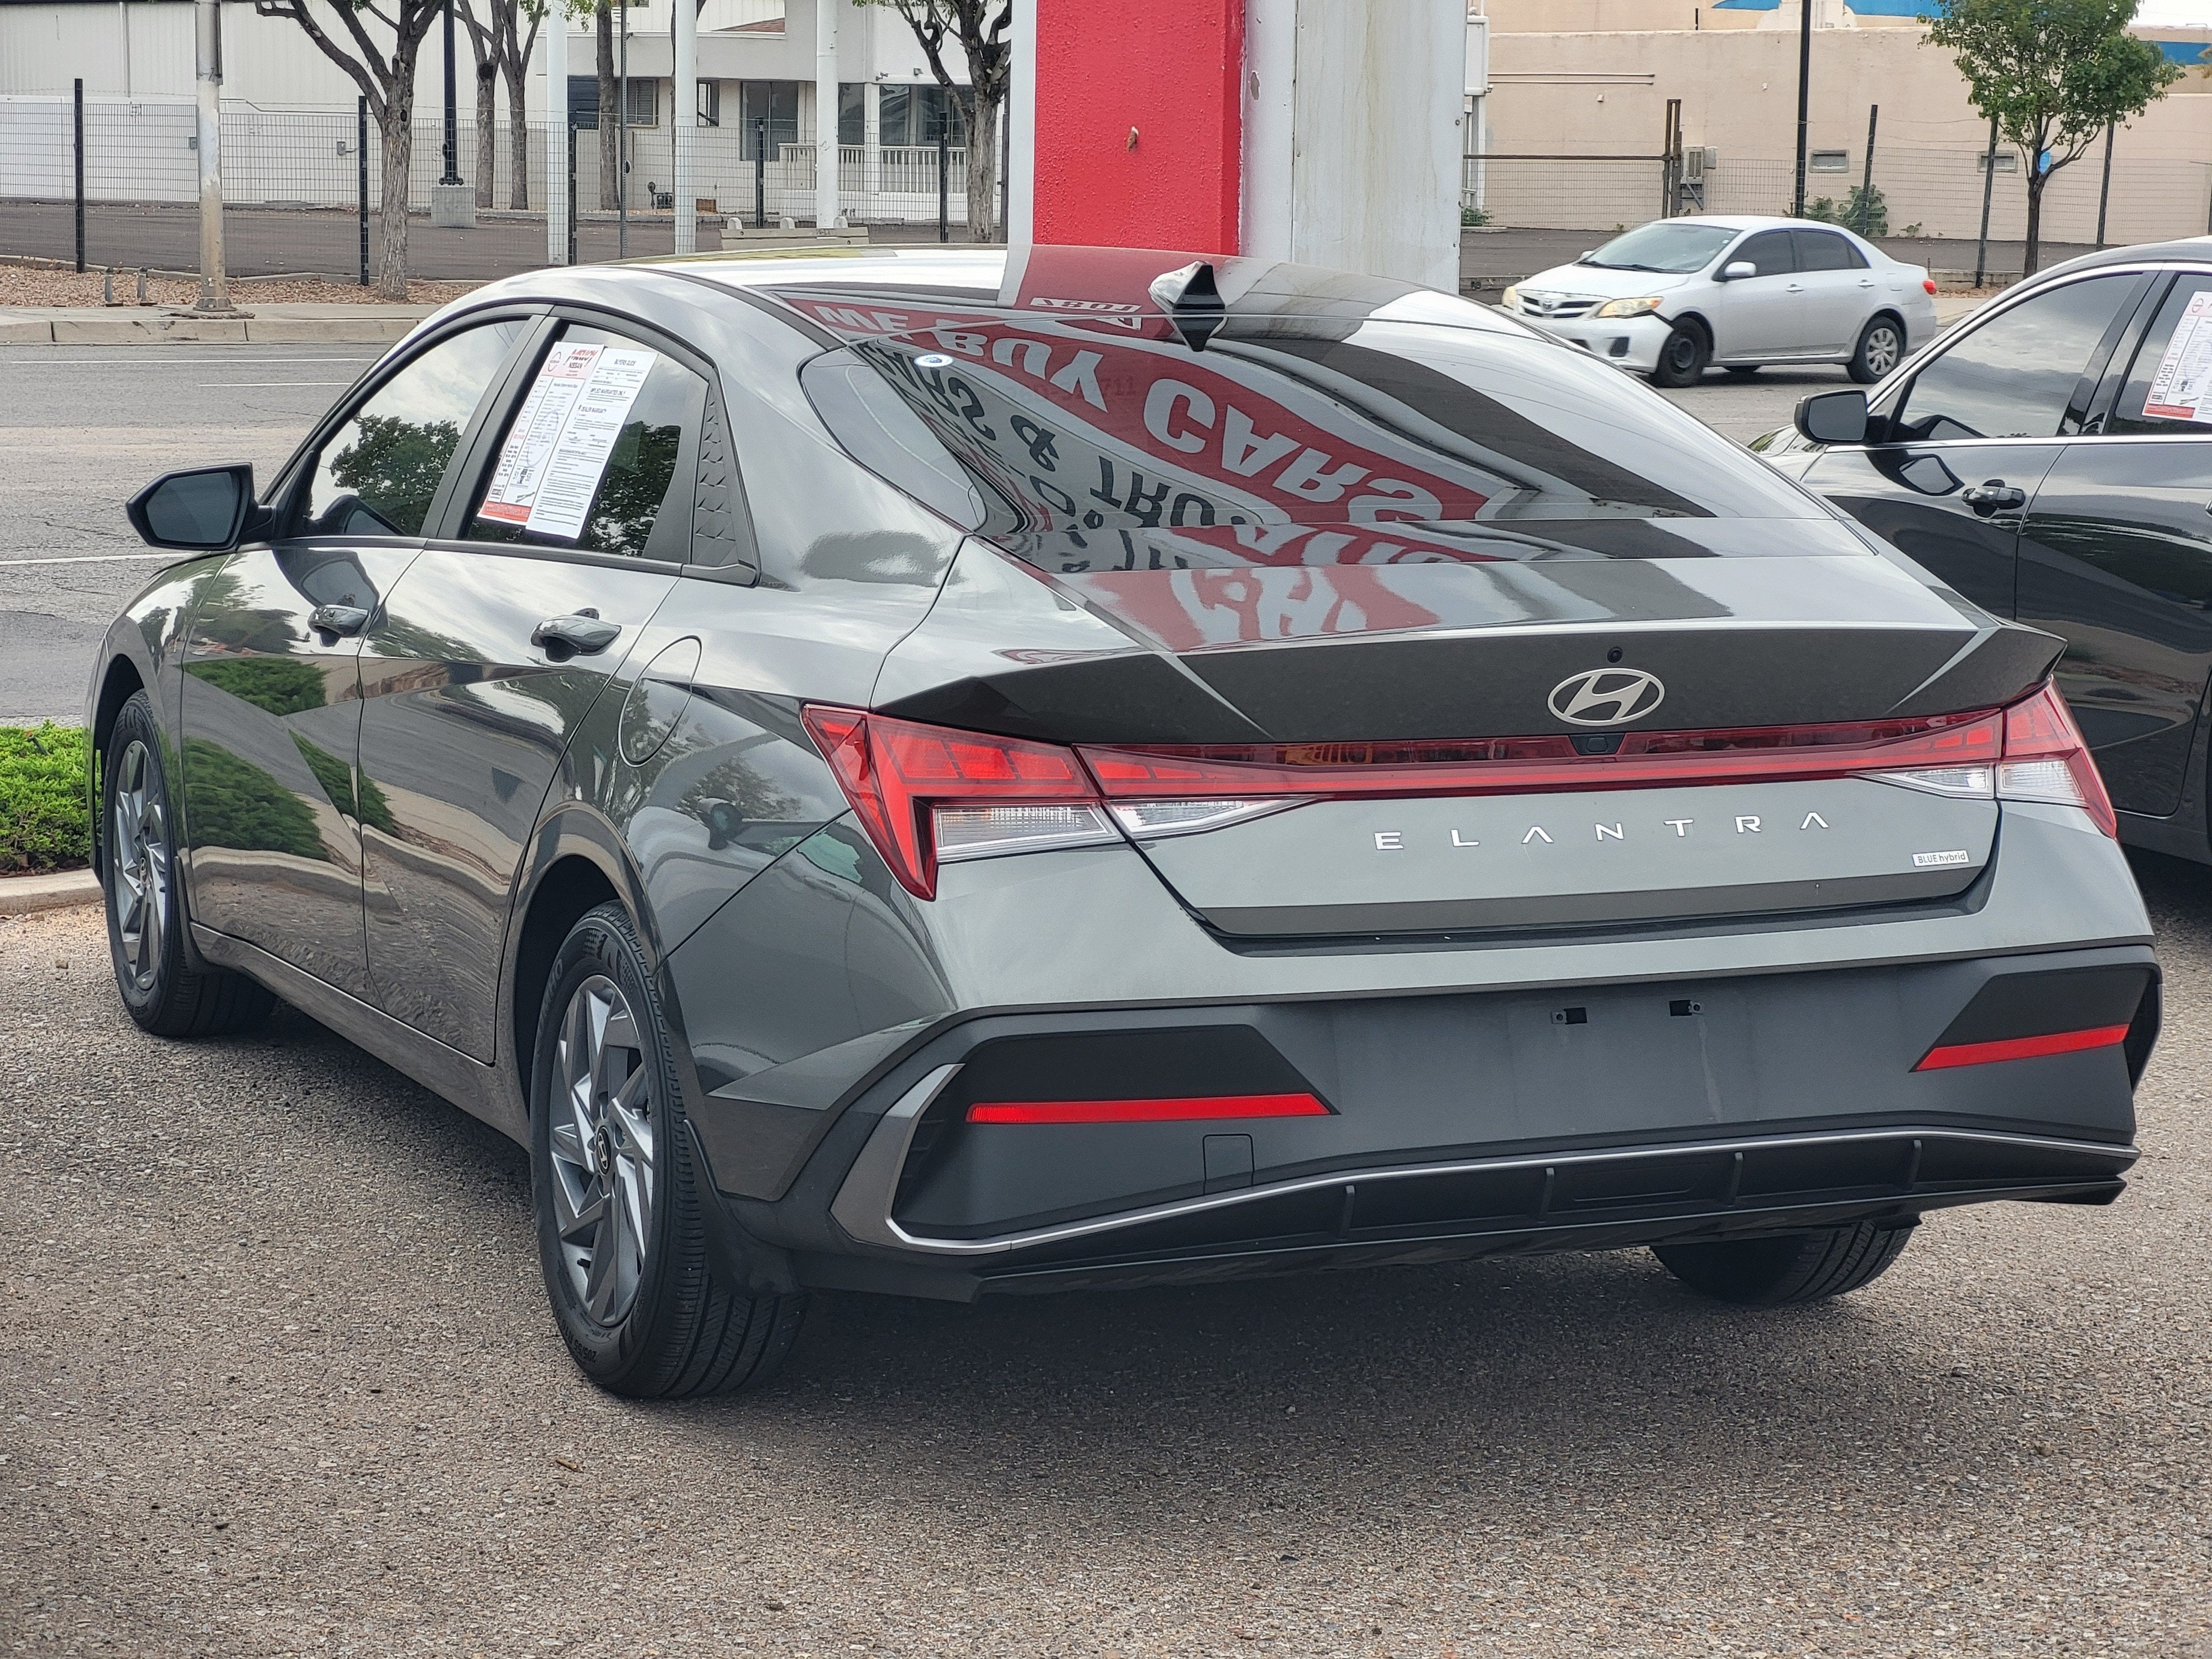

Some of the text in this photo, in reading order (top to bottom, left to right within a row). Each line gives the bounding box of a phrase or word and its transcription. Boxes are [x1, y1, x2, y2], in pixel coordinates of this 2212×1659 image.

[1374, 811, 1829, 851] ELANTRA
[1918, 852, 1966, 864] BLUE hybrid
